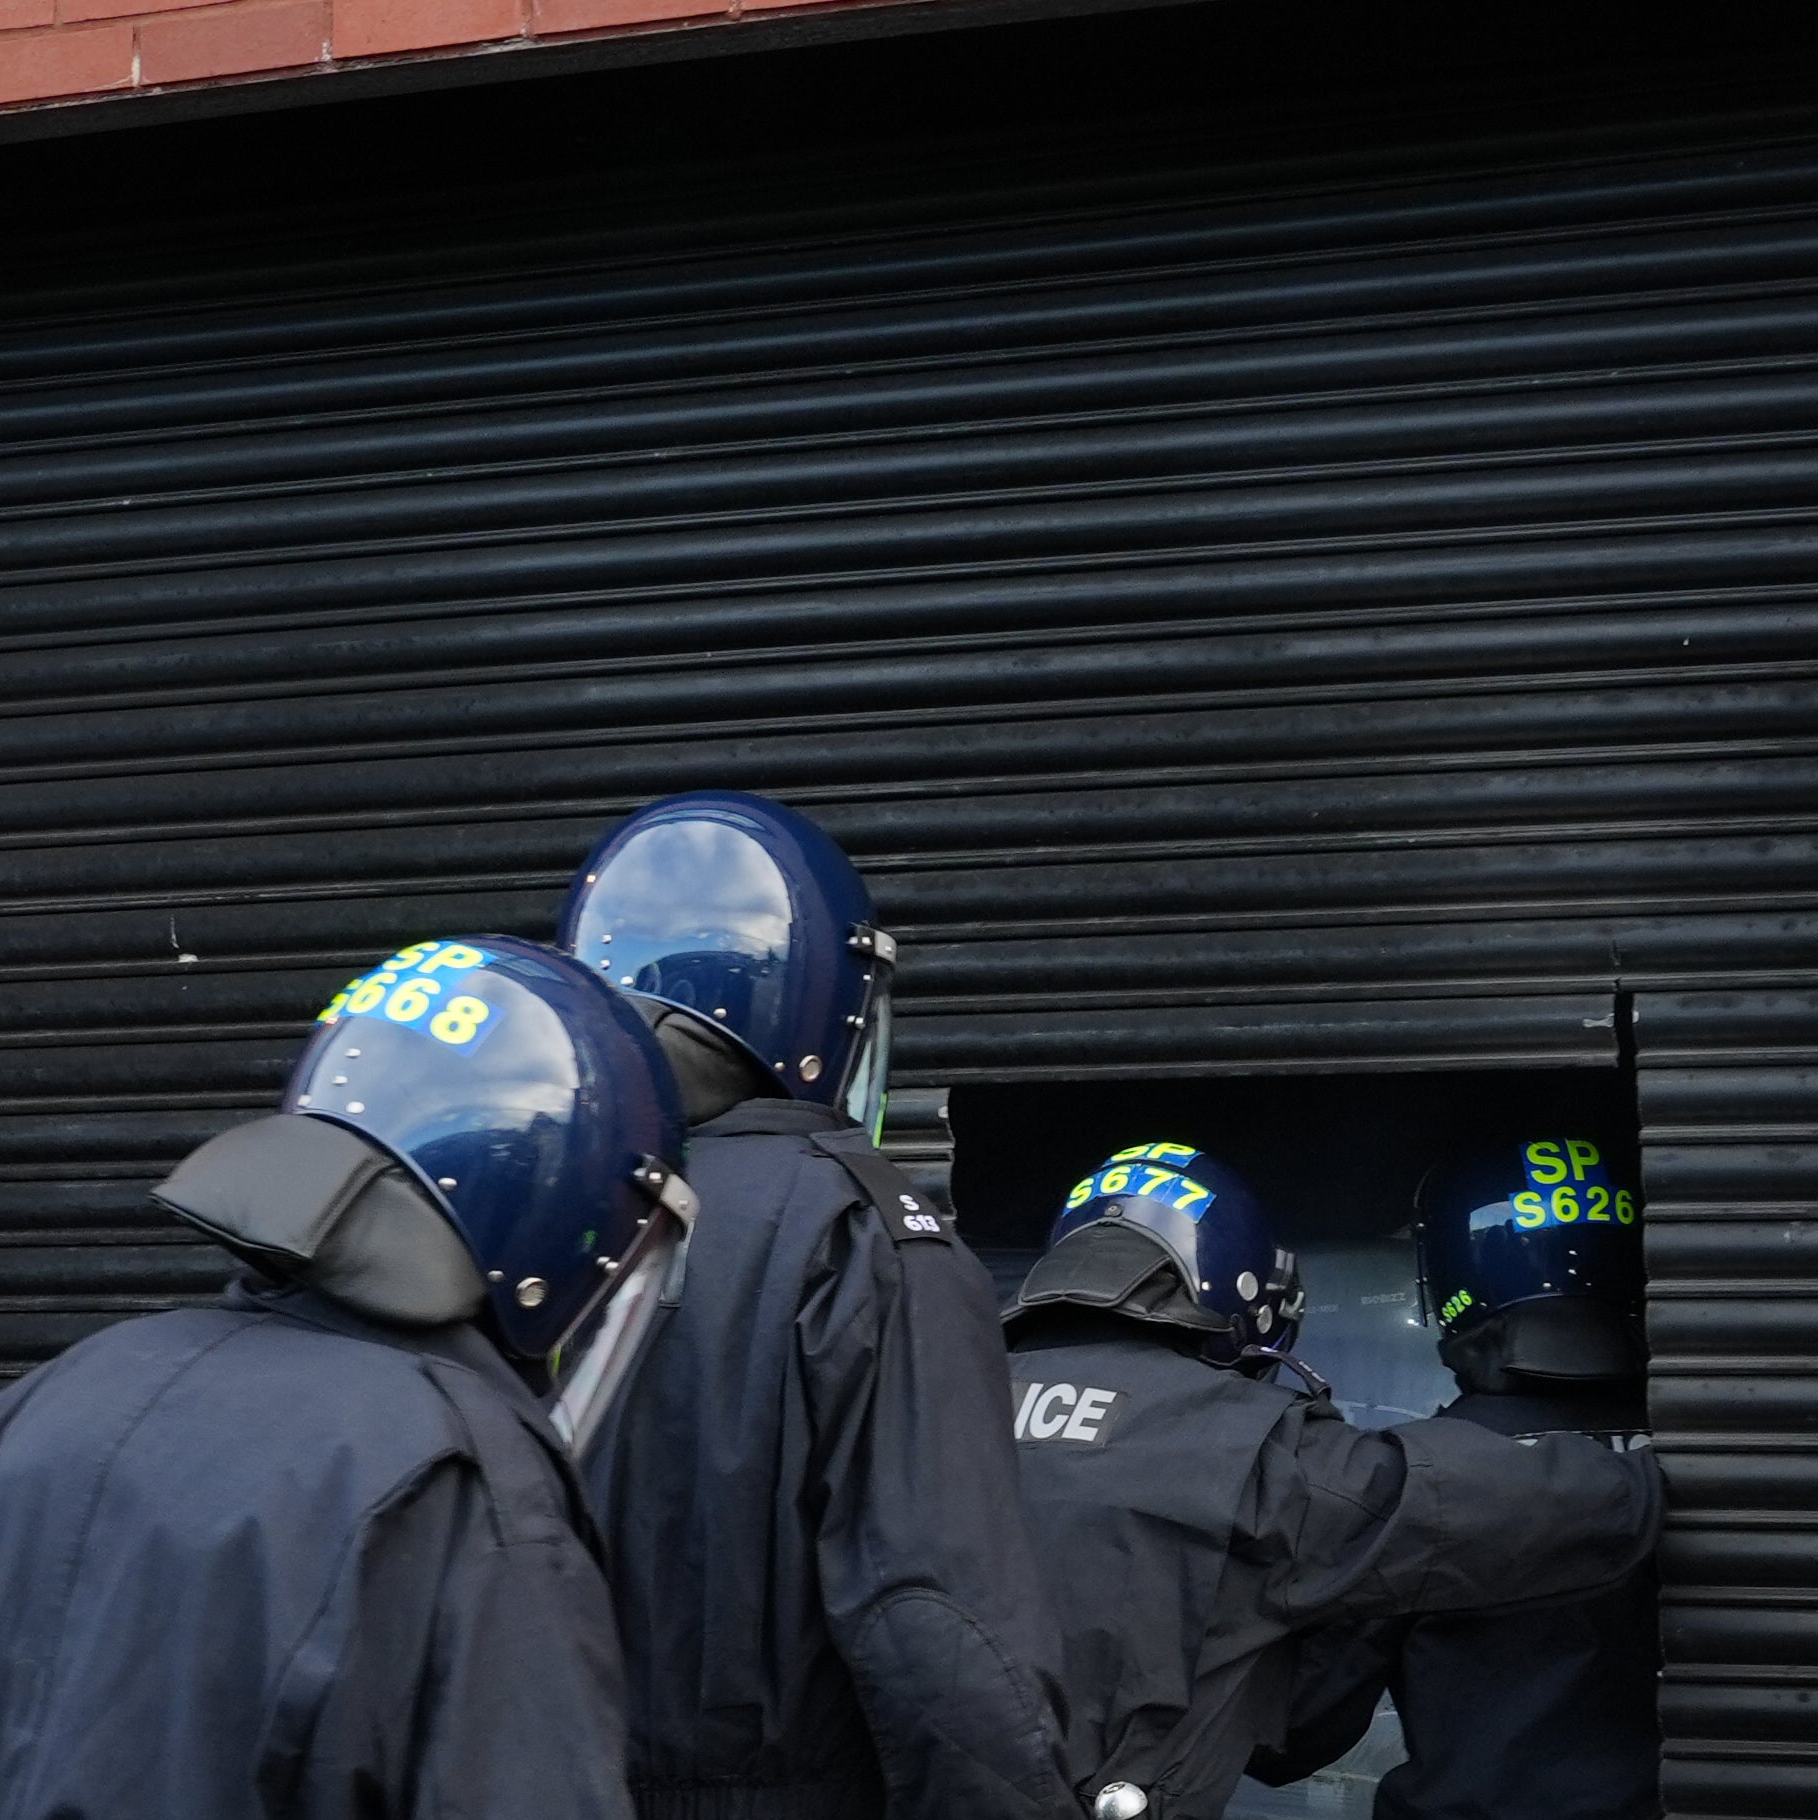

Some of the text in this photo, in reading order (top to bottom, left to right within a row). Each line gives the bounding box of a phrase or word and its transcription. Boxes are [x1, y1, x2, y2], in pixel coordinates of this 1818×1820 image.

[382, 942, 484, 974] SP
[1526, 1140, 1600, 1184] SP
[1066, 1165, 1209, 1210] S677
[1513, 1186, 1635, 1228] S626
